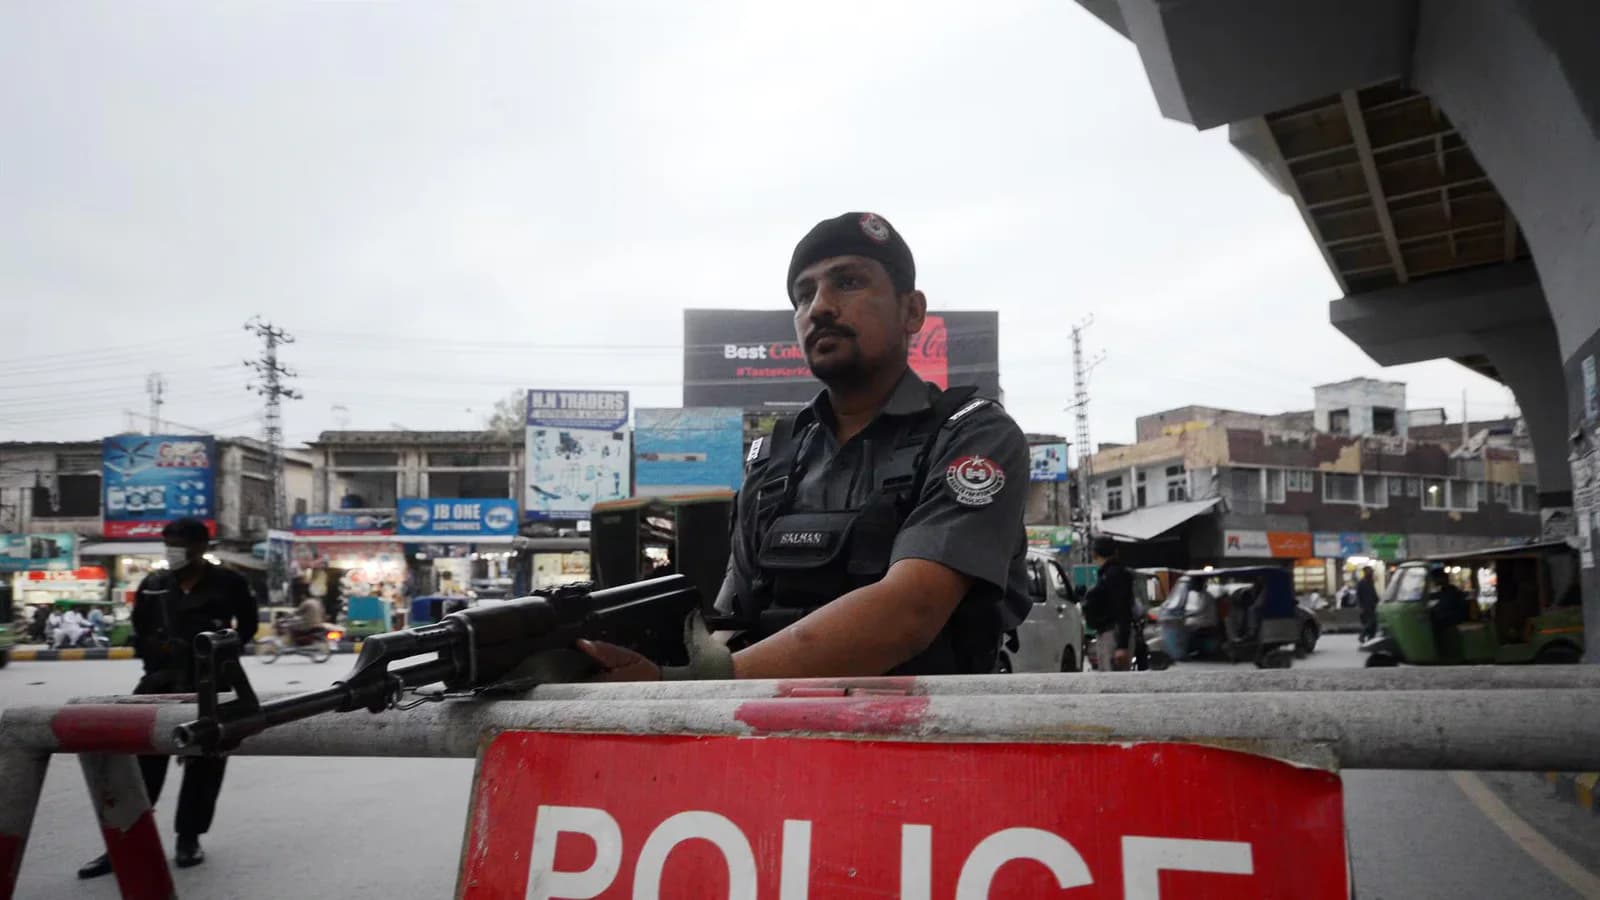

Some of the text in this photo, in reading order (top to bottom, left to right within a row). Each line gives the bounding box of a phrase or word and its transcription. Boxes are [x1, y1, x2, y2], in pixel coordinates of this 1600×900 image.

[724, 343, 803, 360] Best Cok
[560, 391, 625, 410] TRADERS
[453, 504, 481, 519] ONE
[780, 532, 822, 545] SALMAN
